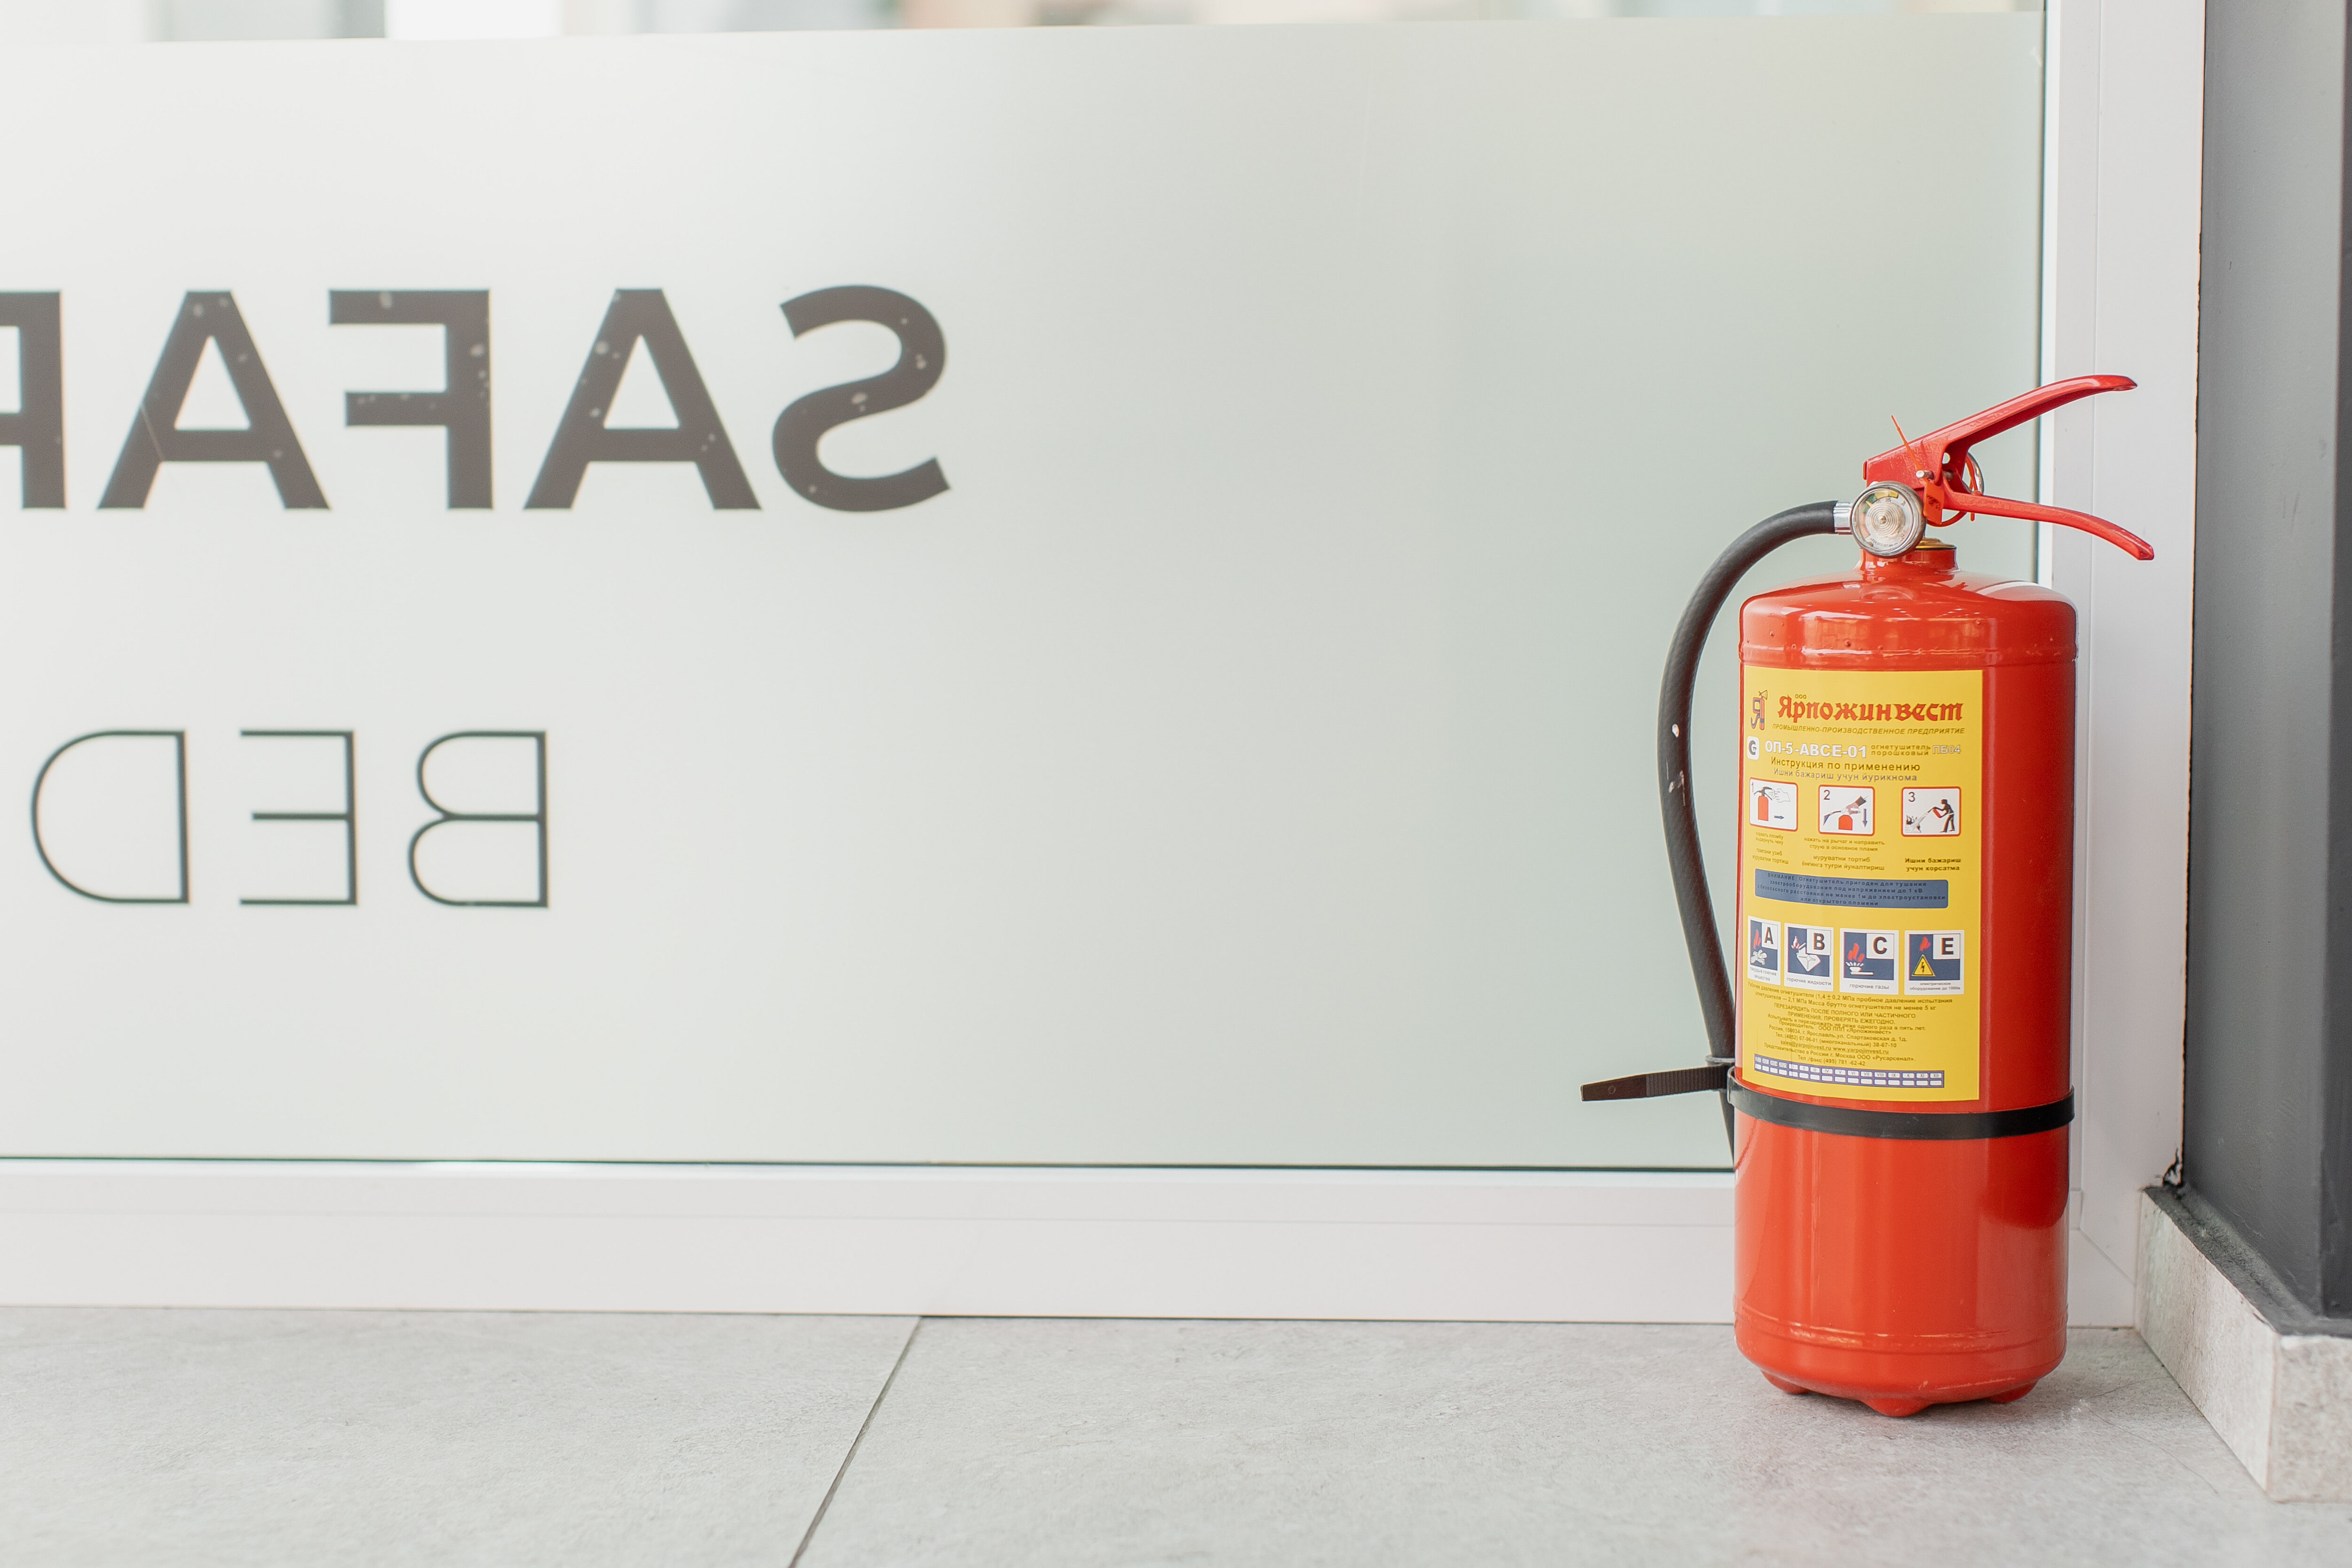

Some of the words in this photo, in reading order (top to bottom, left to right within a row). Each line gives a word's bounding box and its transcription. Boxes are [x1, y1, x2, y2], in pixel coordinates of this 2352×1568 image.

[1778, 694, 1963, 723] Ярпожинвест
[1772, 724, 1905, 734] ПРОМЫШЛЕННО-ПРОИЗВОДСТВЕННОЕ
[1932, 744, 1961, 754] ПБ04
[1771, 756, 1823, 769] Инструкция
[1844, 763, 1921, 772] применению
[1796, 770, 1834, 780] бажариш
[1862, 773, 1917, 782] йурикнома
[1823, 790, 1830, 800] 2
[1908, 792, 1915, 802] 3
[1799, 876, 1843, 884] Огнетушитель
[1764, 927, 1773, 945] A
[1813, 932, 1825, 950] B
[1873, 936, 1887, 954] C
[1941, 937, 1954, 955] E
[1780, 989, 1814, 1000] огнетушителя
[1774, 1003, 1810, 1012] ПЕРЕЗАРЯДИТЬ
